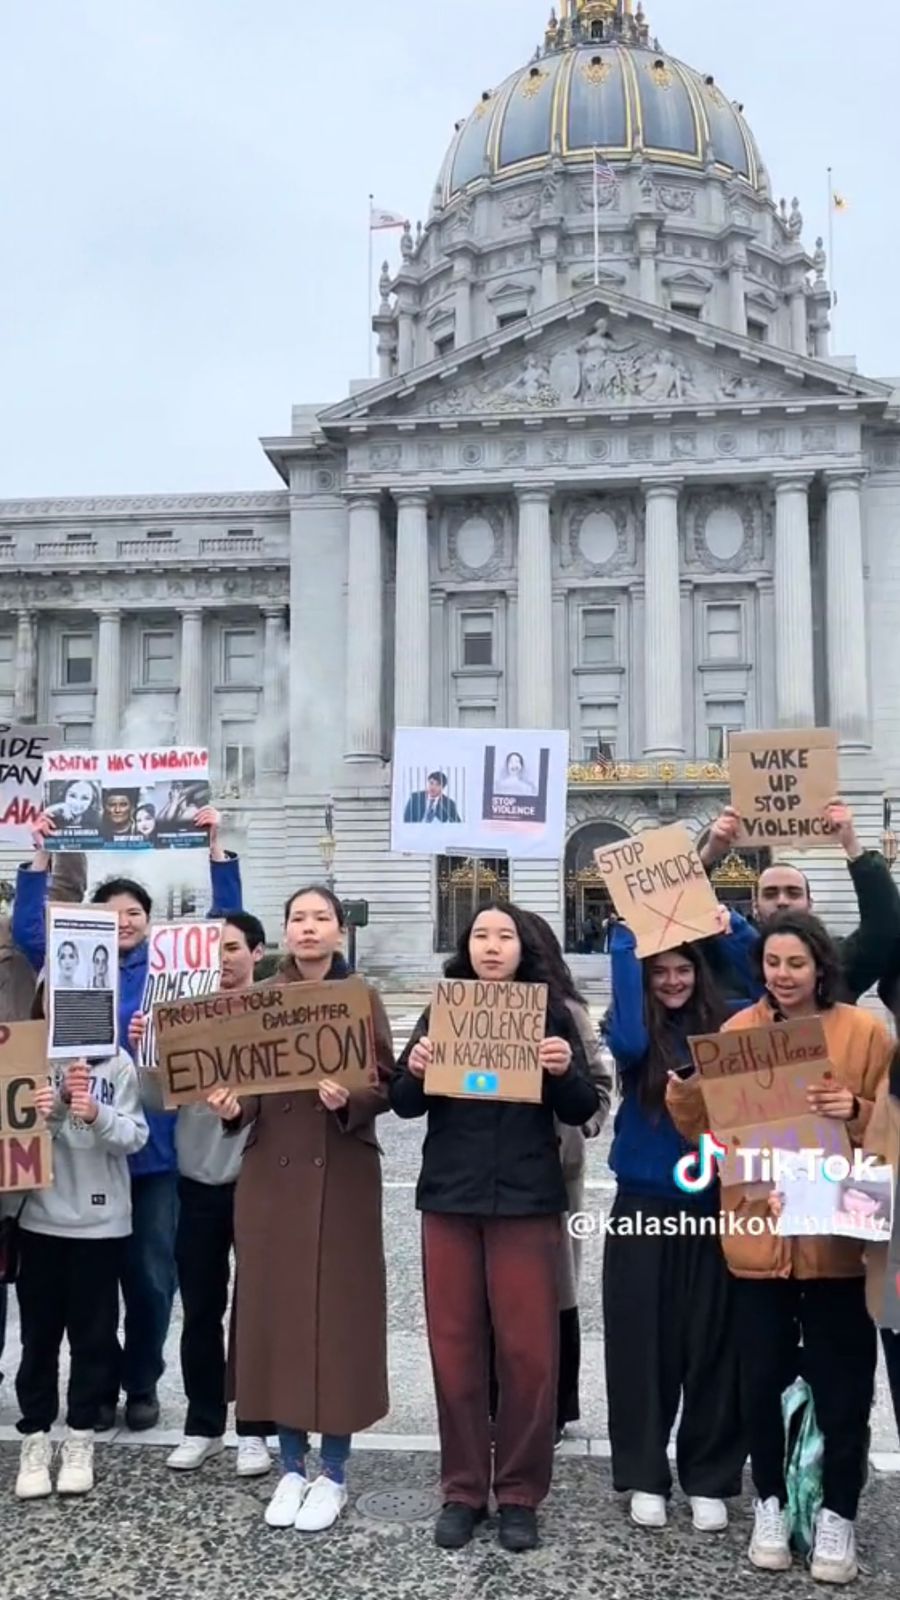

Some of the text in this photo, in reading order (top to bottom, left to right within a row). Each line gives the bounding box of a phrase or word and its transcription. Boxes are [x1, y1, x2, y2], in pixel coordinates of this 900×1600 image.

[107, 753, 134, 771] НАС
[750, 749, 809, 770] WAKE
[768, 774, 798, 792] UP
[491, 796, 517, 806] STOP
[491, 806, 536, 816] VIOLENCE
[754, 795, 801, 813] STOP
[599, 841, 645, 875] STOP
[624, 850, 703, 902] FEMICIDE
[151, 926, 220, 971] STOP
[437, 982, 546, 1011] NO DOMESTIC
[157, 991, 283, 1032] PROTECT YOUR
[262, 1003, 350, 1031] DAUGHTER
[449, 1010, 542, 1042] VIOLENCE
[166, 1040, 287, 1094] EDUCATE
[430, 1042, 540, 1072] IN KAZAKHSTAN
[694, 1036, 774, 1089] Pretty
